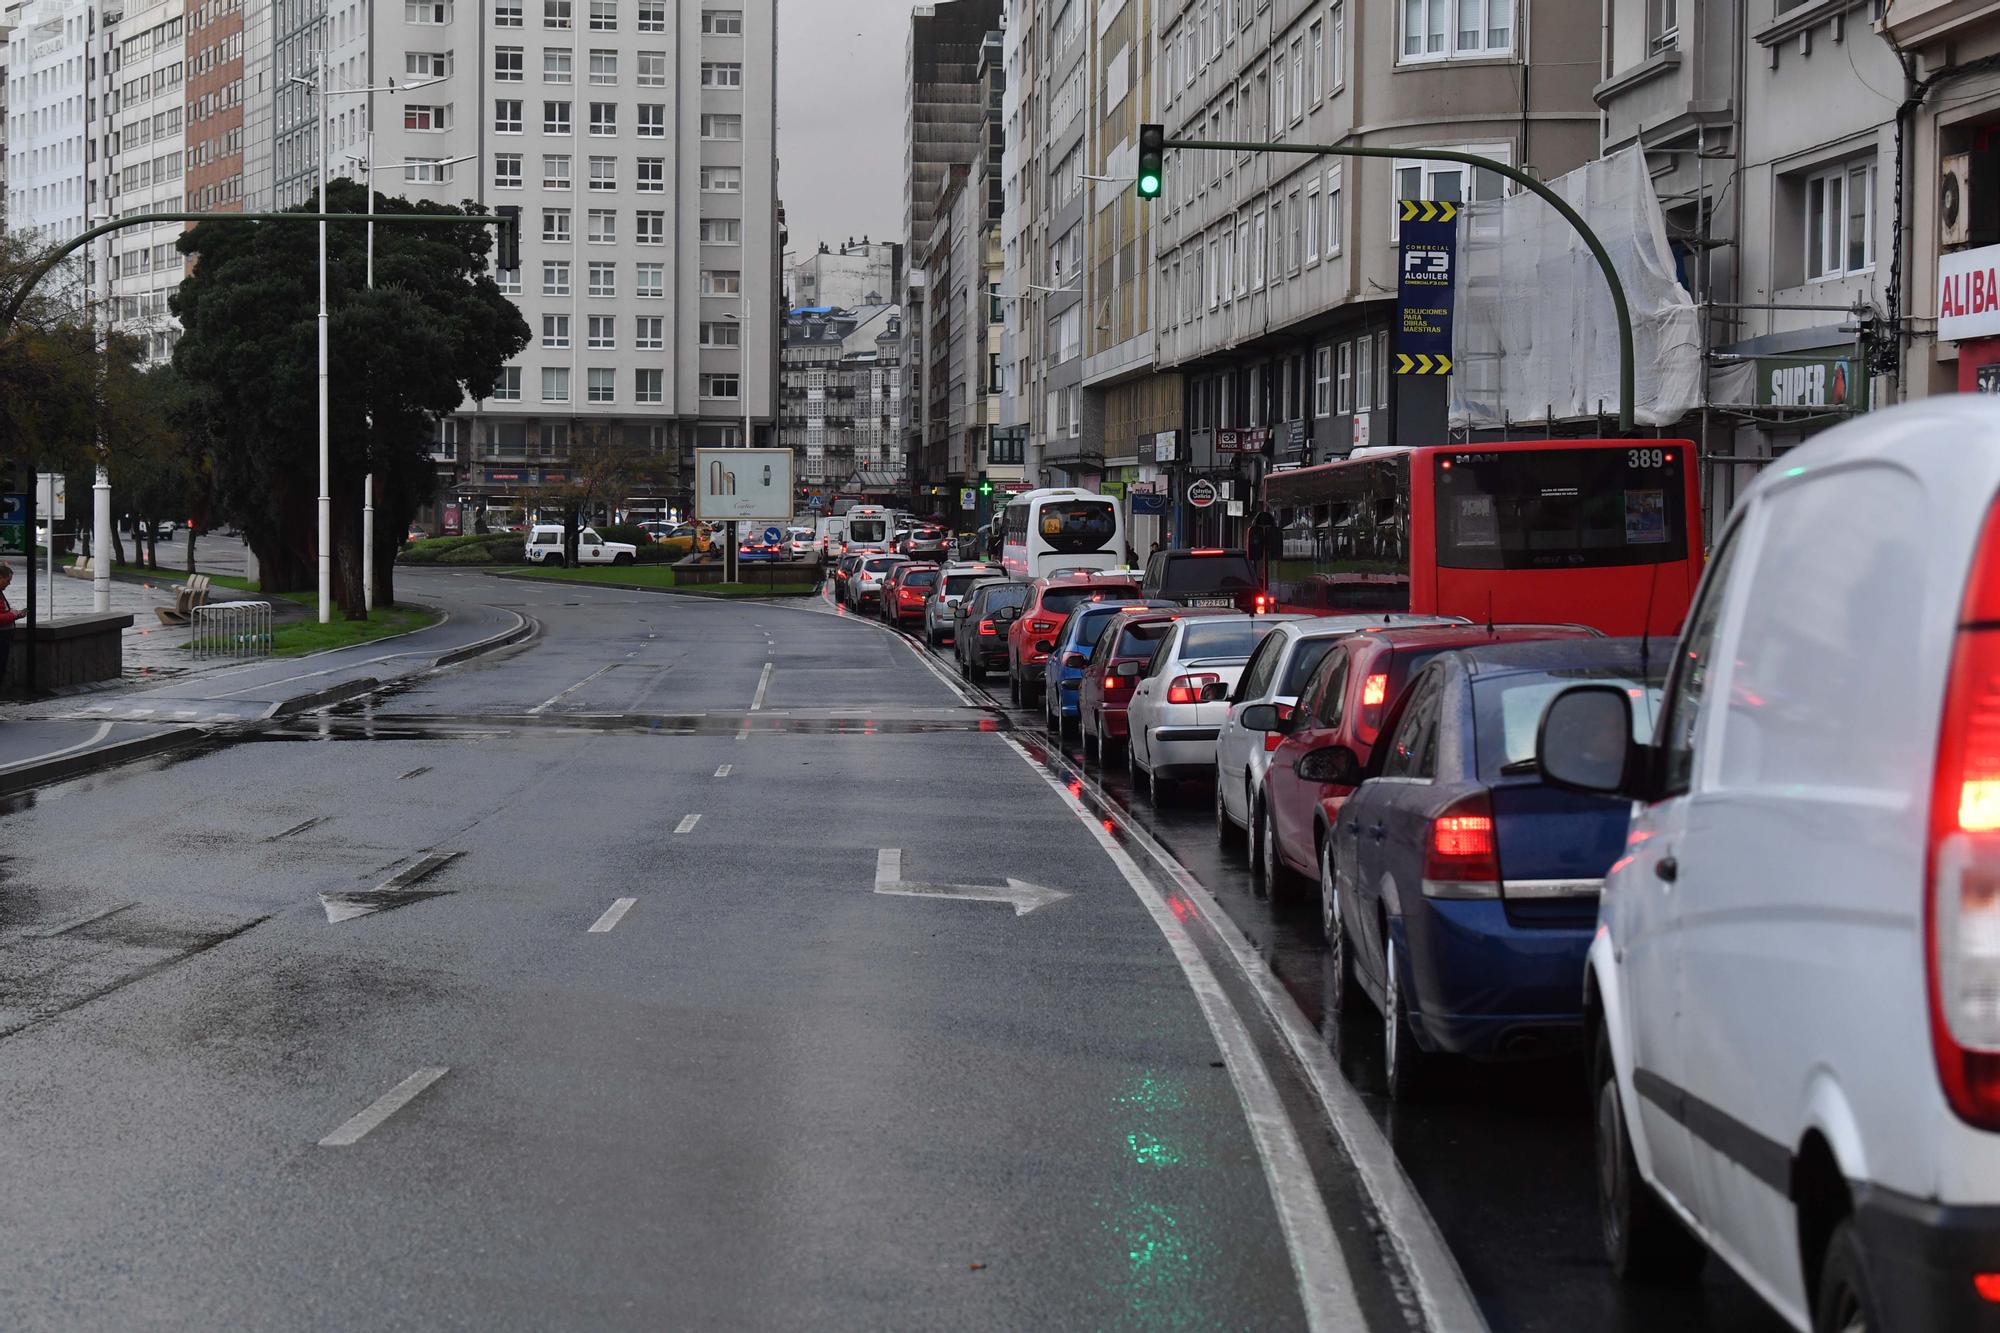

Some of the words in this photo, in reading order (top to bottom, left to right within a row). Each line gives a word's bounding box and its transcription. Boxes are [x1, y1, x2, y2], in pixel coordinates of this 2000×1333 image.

[1405, 251, 1449, 272] F3
[1405, 272, 1448, 280] ALQUILER
[1771, 364, 1826, 405] SUPER
[1455, 454, 1499, 464] MAN
[1628, 449, 1663, 469] 389
